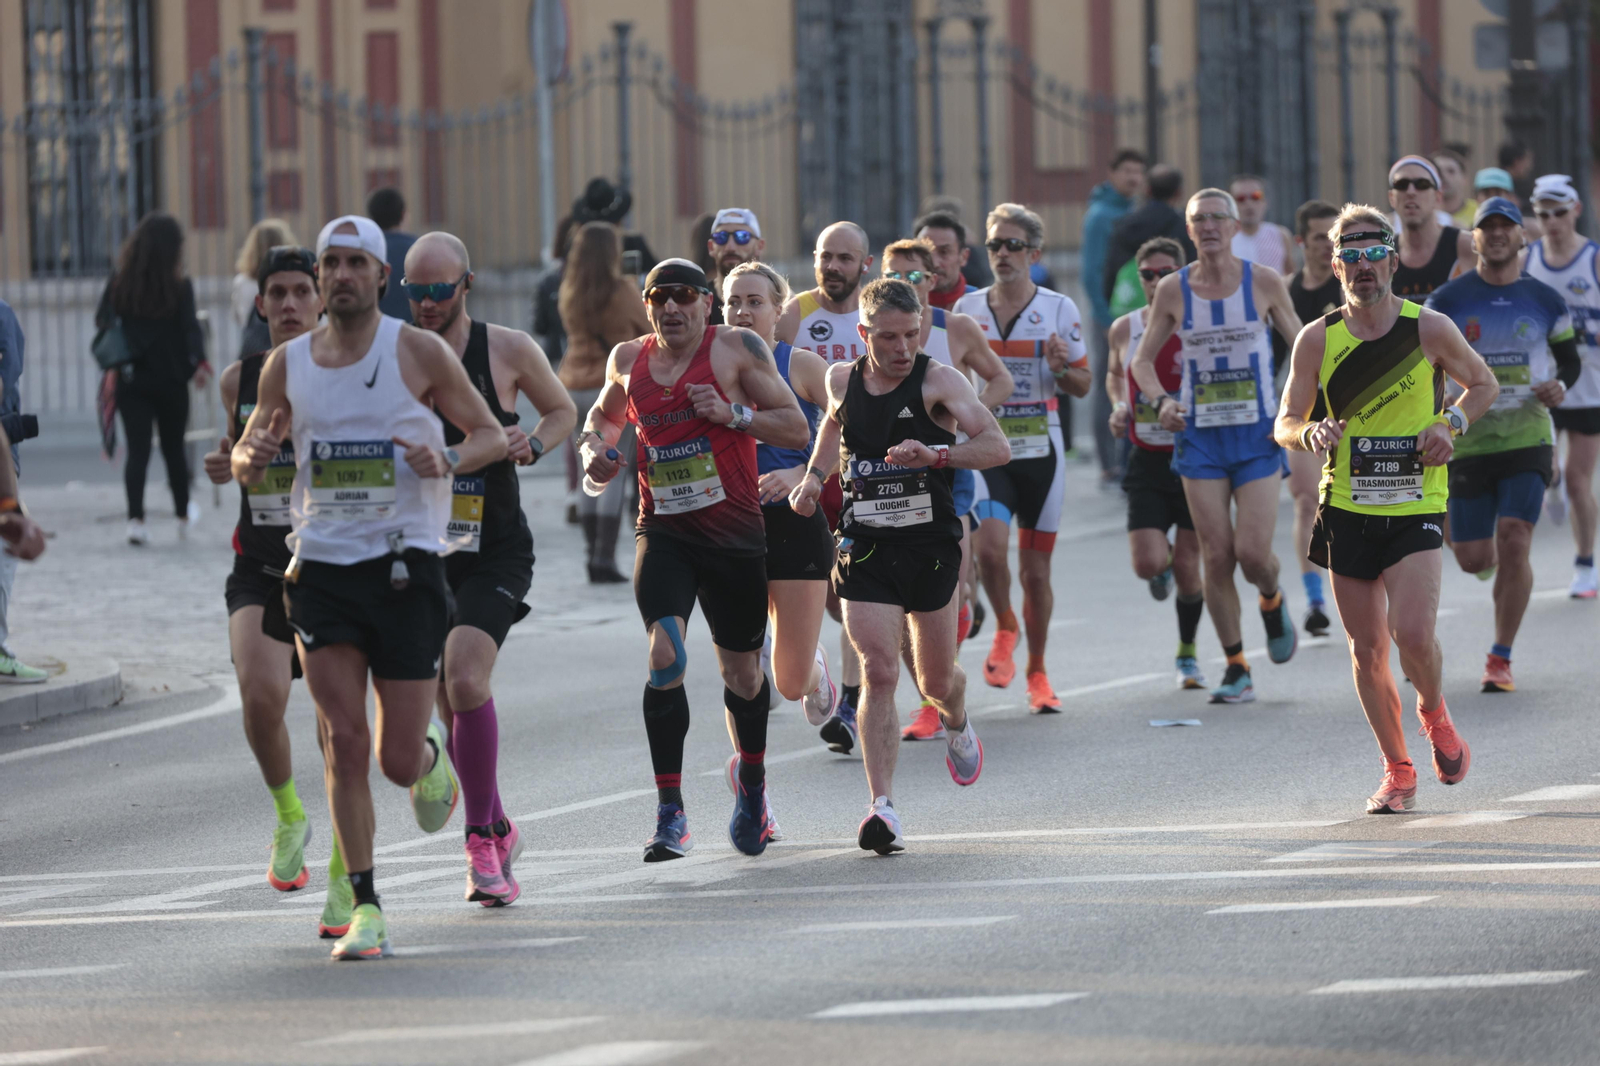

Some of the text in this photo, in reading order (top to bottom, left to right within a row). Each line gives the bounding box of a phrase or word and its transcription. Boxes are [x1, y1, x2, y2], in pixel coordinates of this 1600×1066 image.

[1487, 354, 1523, 365] ZURICH
[1213, 371, 1249, 381] ZURICH
[334, 443, 384, 457] ZURICH
[659, 441, 702, 460] ZURICH
[1374, 440, 1414, 450] ZURICH
[1374, 461, 1400, 473] 2189
[665, 468, 691, 481] 1123
[877, 482, 904, 495] 2750
[1356, 478, 1416, 488] TRASMONTANA
[334, 490, 369, 501] ADRIAN
[671, 485, 694, 497] RAFA
[874, 499, 910, 511] LOUGHIE
